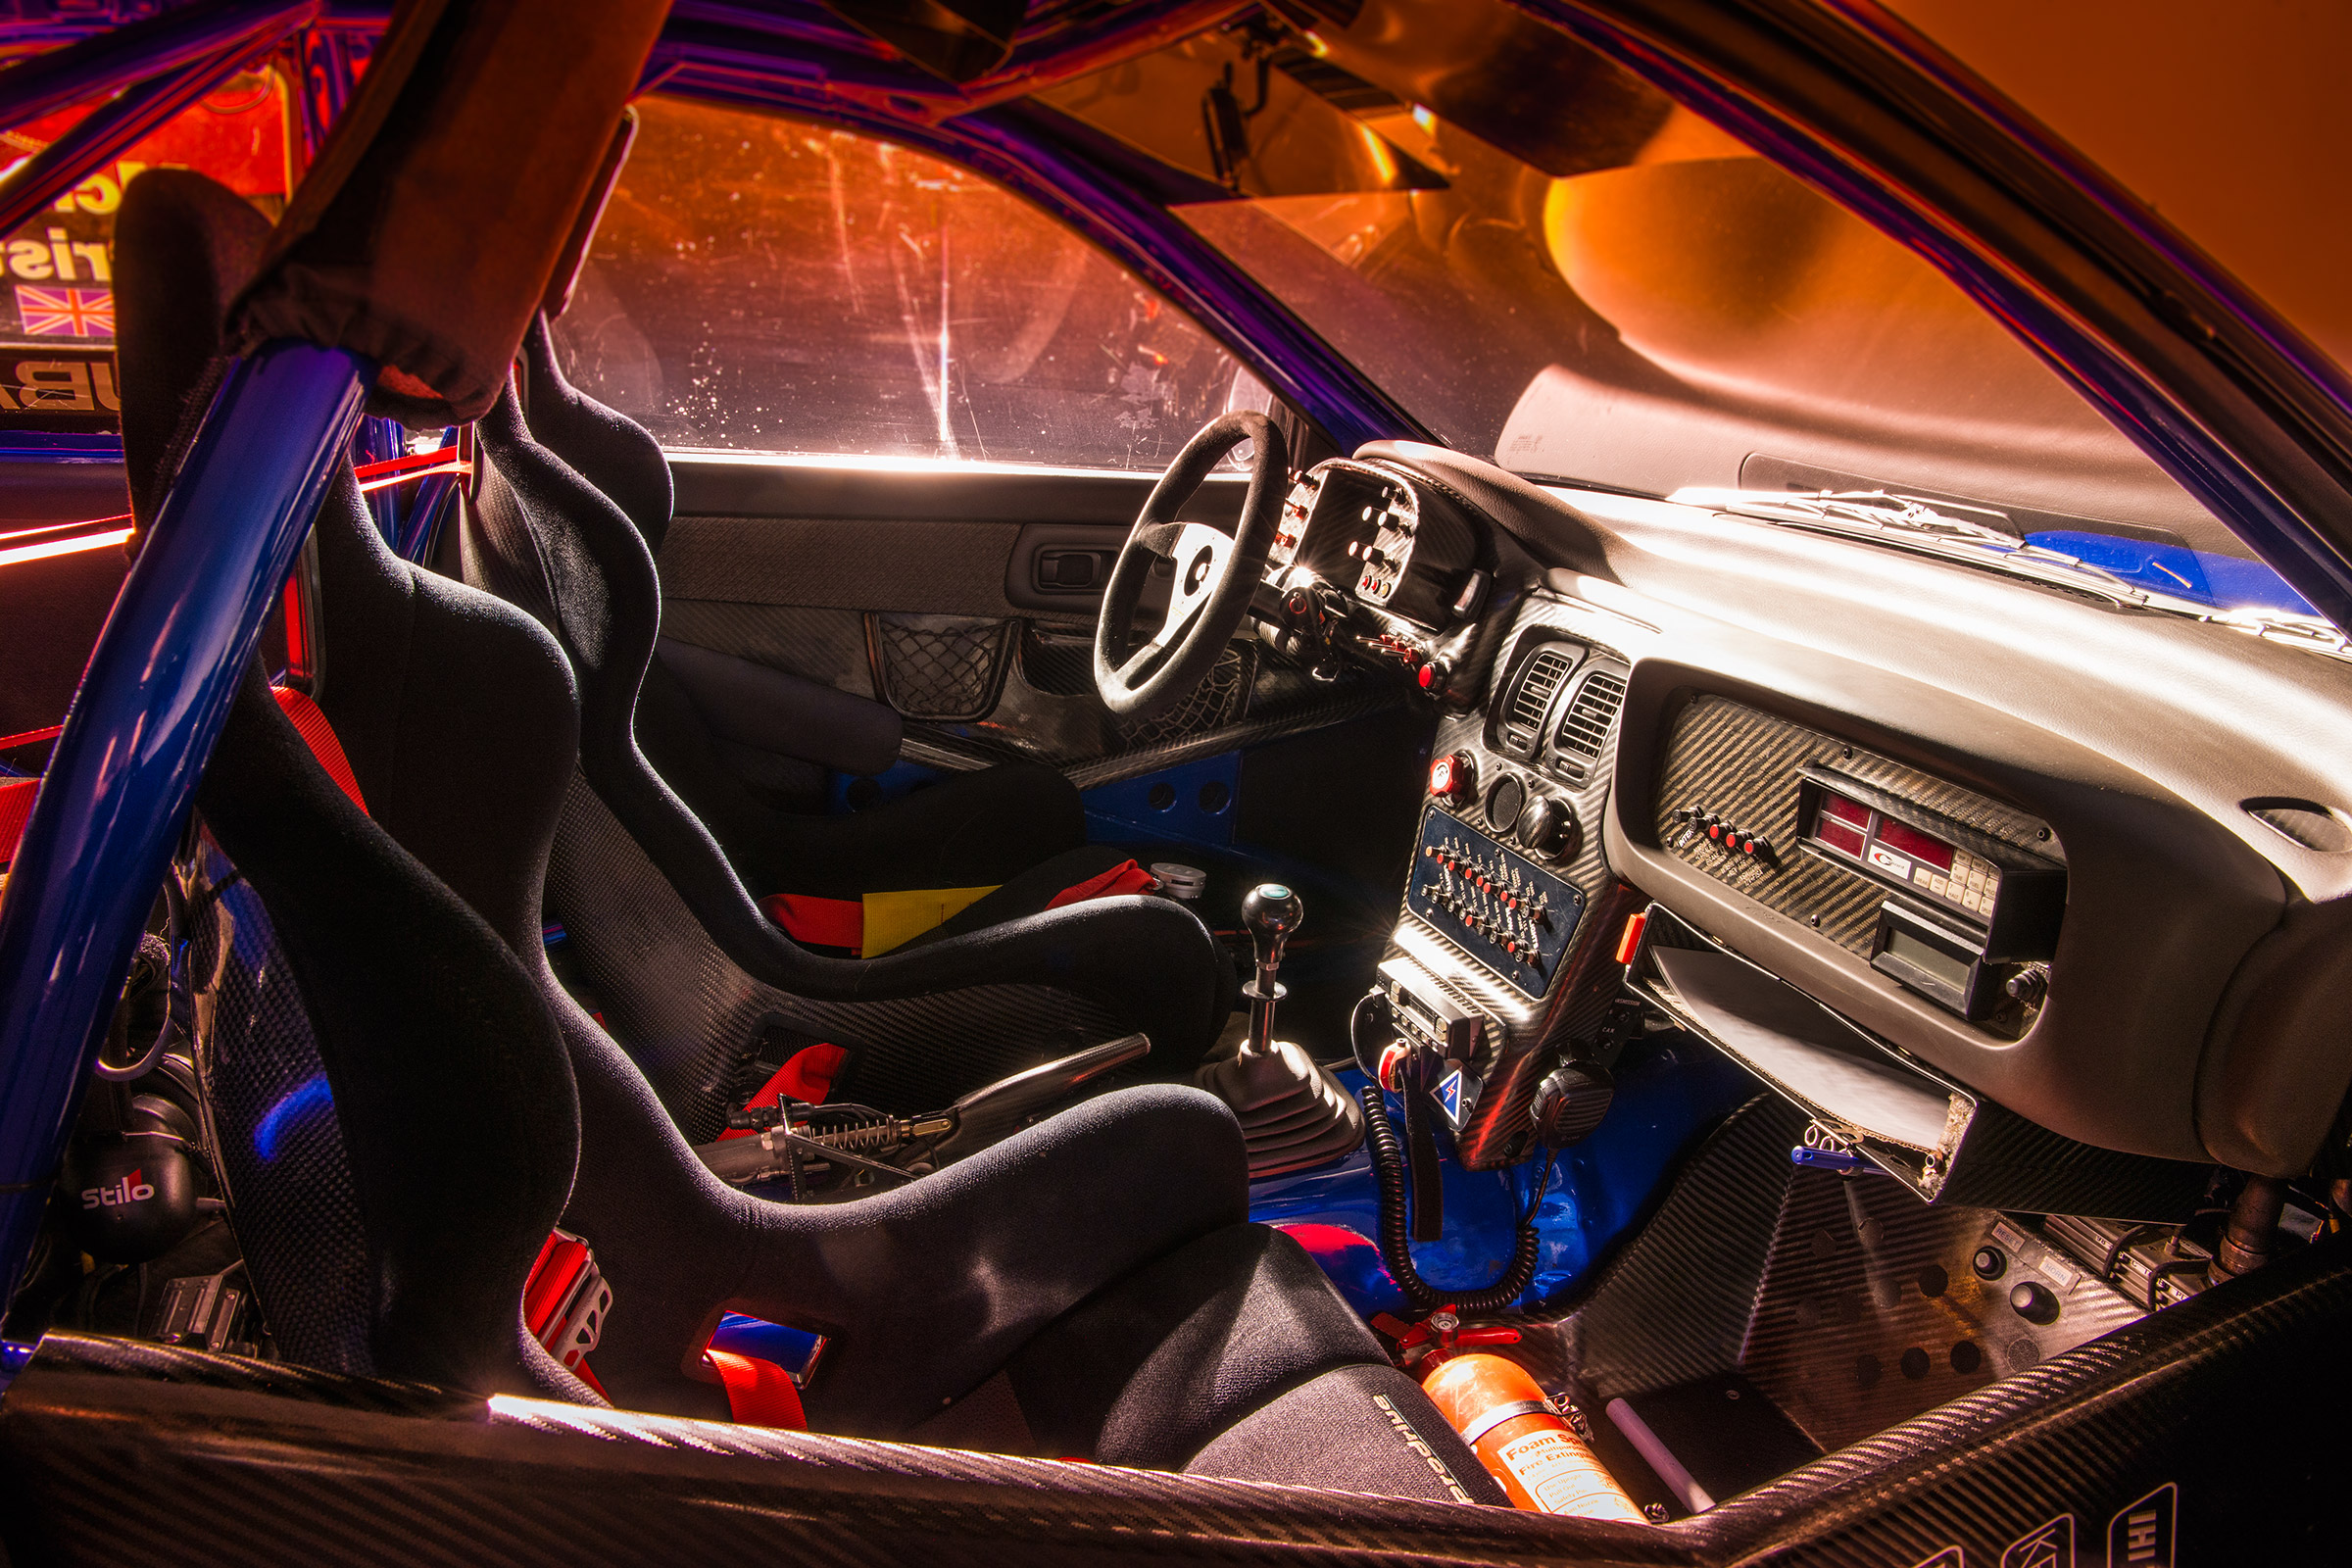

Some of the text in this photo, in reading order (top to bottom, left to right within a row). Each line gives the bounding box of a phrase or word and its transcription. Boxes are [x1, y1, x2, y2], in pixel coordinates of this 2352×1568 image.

[81, 1176, 155, 1210] stilo
[1995, 1228, 2020, 1247] RESET
[2044, 1263, 2067, 1282] HORN
[1505, 1436, 1556, 1461] Foam
[1518, 1458, 1544, 1476] Fire
